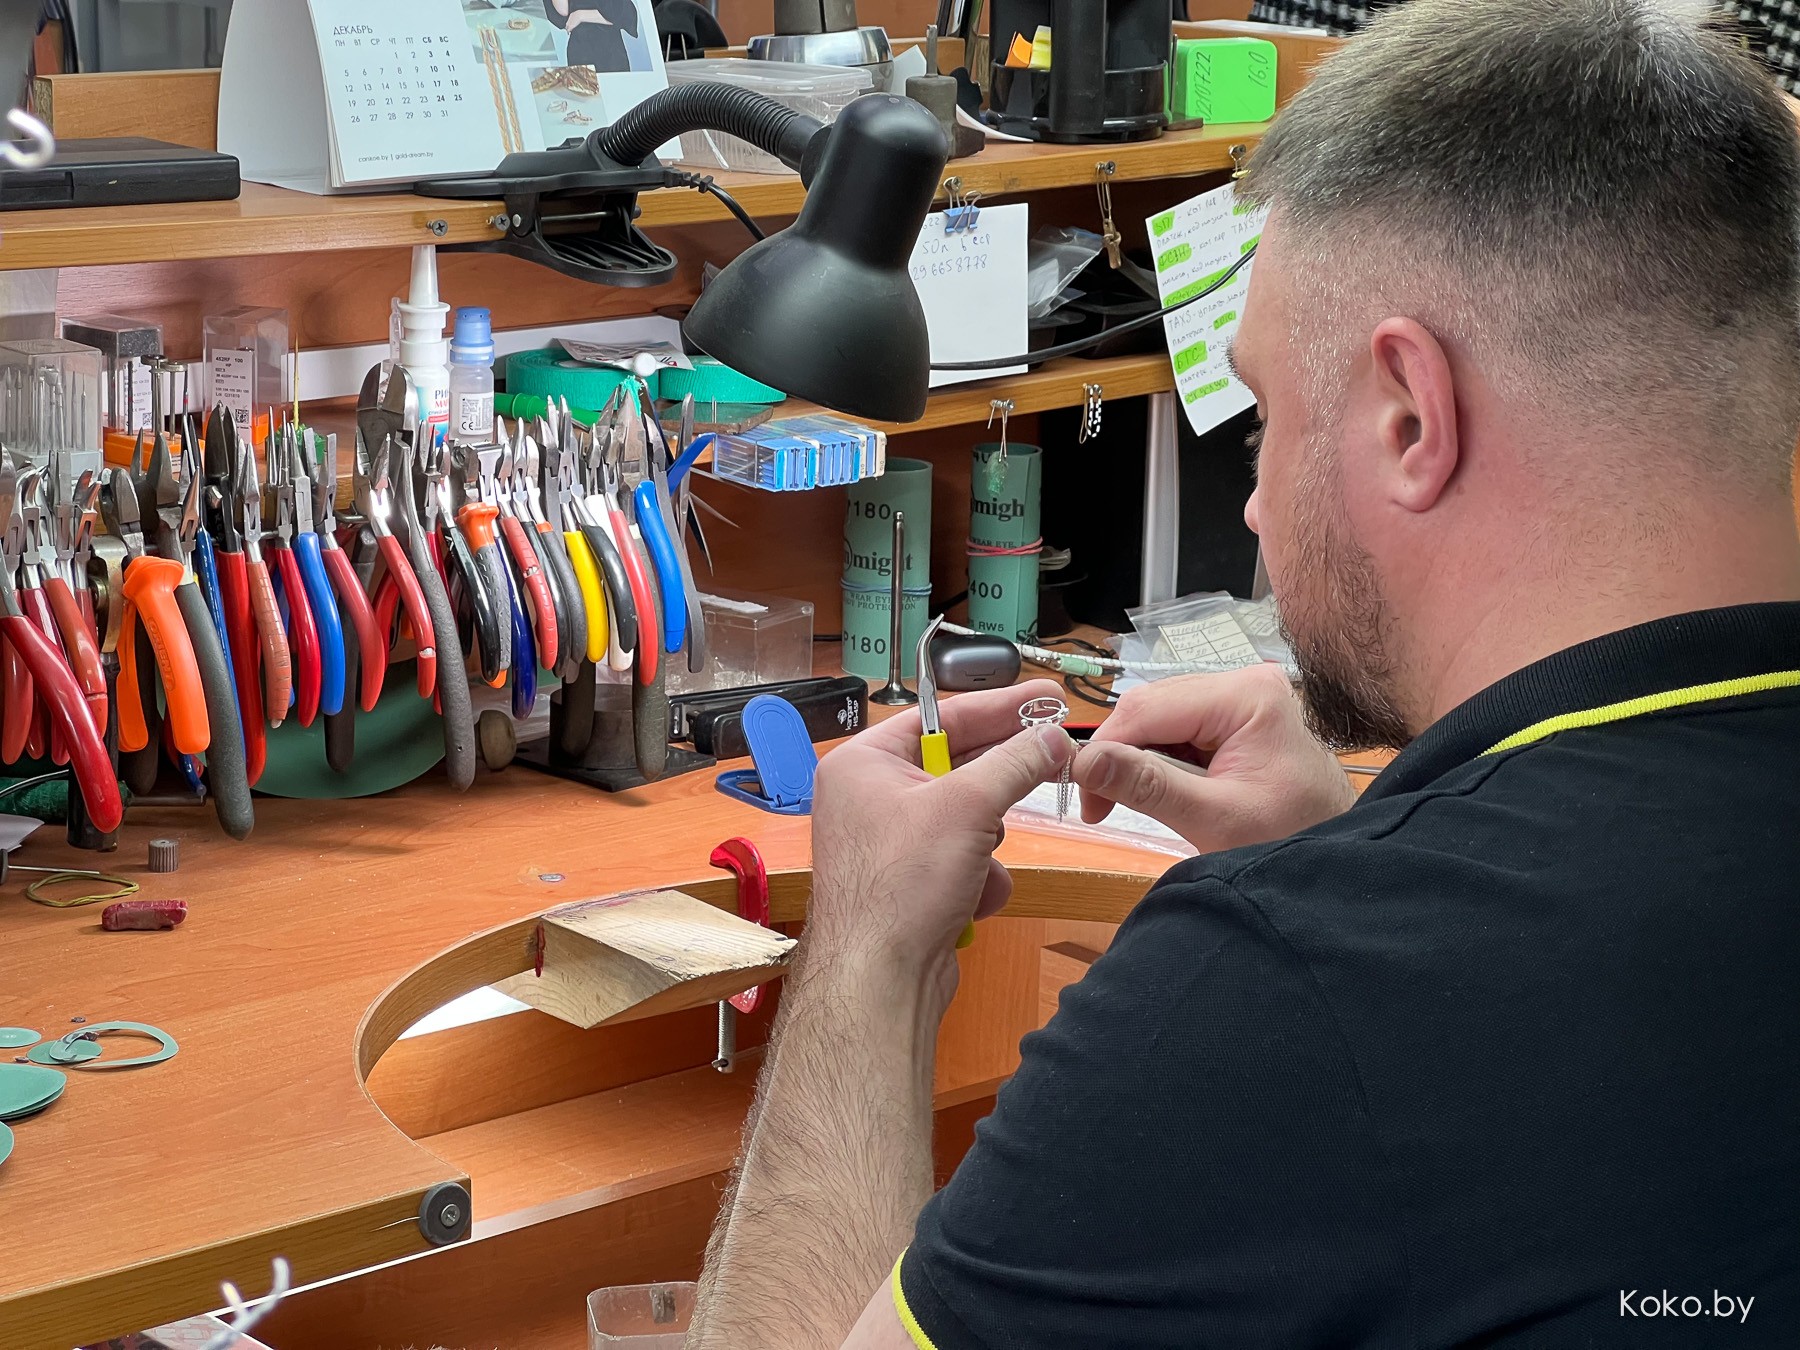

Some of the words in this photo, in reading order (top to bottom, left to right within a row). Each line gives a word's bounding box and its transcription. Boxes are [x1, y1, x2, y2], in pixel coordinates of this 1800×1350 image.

[333, 24, 373, 36] ДЕКАБРЬ
[334, 39, 346, 47] ПН
[353, 38, 362, 47] ВТ
[370, 37, 381, 46] СР
[388, 37, 397, 46] ЧТ
[405, 36, 414, 45] ПТ
[421, 36, 433, 44] СБ
[438, 35, 450, 44] ВС
[429, 64, 439, 73] 10
[447, 64, 456, 73] 11
[1247, 50, 1269, 88] 16.0
[344, 84, 354, 93] 12
[363, 83, 373, 92] 13
[381, 82, 390, 91] 14
[398, 81, 408, 90] 15
[415, 80, 425, 89] 16
[432, 79, 441, 88] 17
[450, 79, 460, 87] 18
[347, 99, 357, 108] 19
[366, 98, 376, 107] 20
[384, 96, 394, 106] 21
[401, 96, 412, 105] 22
[419, 95, 429, 104] 23
[436, 94, 446, 103] 24
[453, 93, 463, 102] 25
[350, 115, 361, 124] 26
[368, 113, 378, 122] 27
[387, 112, 397, 121] 28
[404, 111, 414, 120] 29
[422, 110, 432, 119] 30
[440, 109, 449, 118] 31
[847, 499, 891, 520] 180
